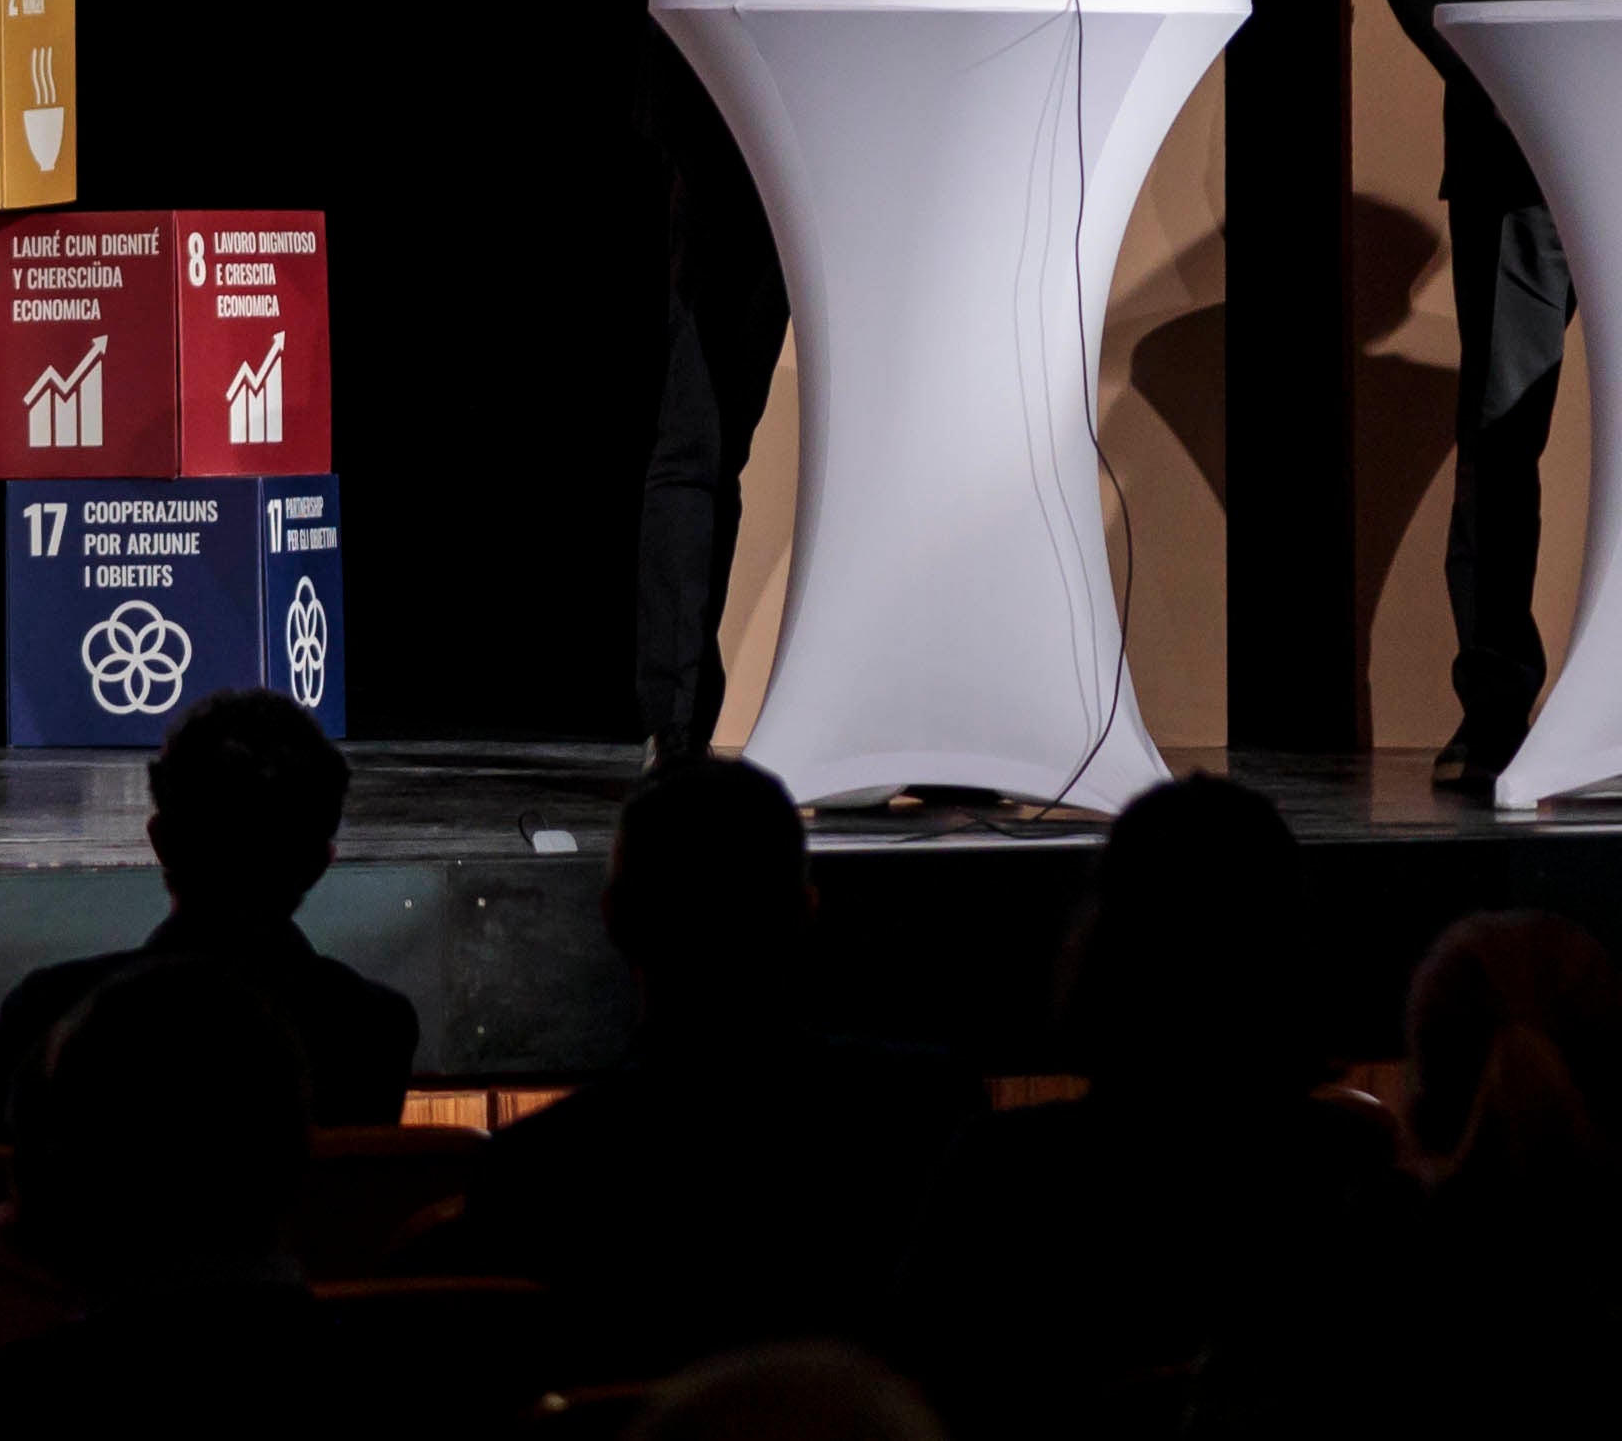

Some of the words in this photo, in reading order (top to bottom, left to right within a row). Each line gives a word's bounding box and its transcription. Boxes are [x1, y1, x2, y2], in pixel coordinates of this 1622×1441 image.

[13, 230, 60, 258] LAURÉ
[65, 234, 97, 257] CUN
[102, 226, 159, 256] DIGNITÉ
[214, 232, 256, 254] LAVORO
[259, 231, 317, 254] DIGNITOSO
[188, 232, 206, 287] 8
[13, 268, 22, 290] Y
[27, 261, 123, 289] CHERSCIÜDA
[216, 265, 223, 286] E
[226, 263, 276, 286] CRESCITA
[13, 298, 101, 322] ECONOMICA
[217, 294, 280, 318] ECONOMICA
[84, 500, 218, 524] COOPERAZIUNS
[23, 502, 68, 557] 17
[267, 499, 282, 553] 17
[84, 533, 121, 555] POR
[126, 532, 200, 555] ARJUNJE
[85, 566, 90, 587] I
[96, 565, 173, 587] OBIETIFS
